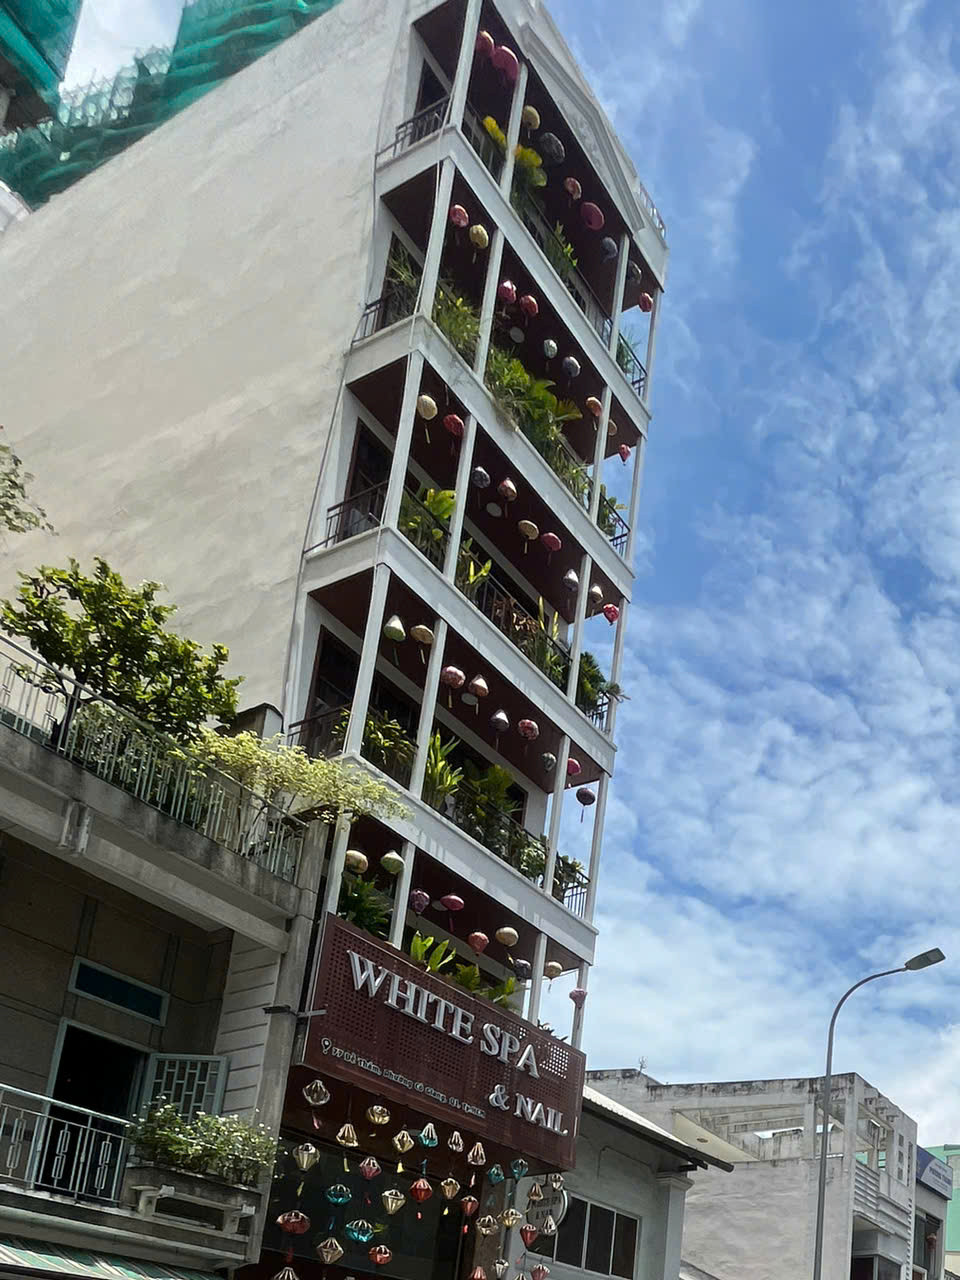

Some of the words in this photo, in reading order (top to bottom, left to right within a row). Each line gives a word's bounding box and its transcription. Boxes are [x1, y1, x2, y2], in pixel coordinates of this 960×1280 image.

[346, 949, 475, 1045] WHITE
[480, 1023, 540, 1079] SPA
[489, 1084, 510, 1111] &
[513, 1093, 568, 1136] NAIL
